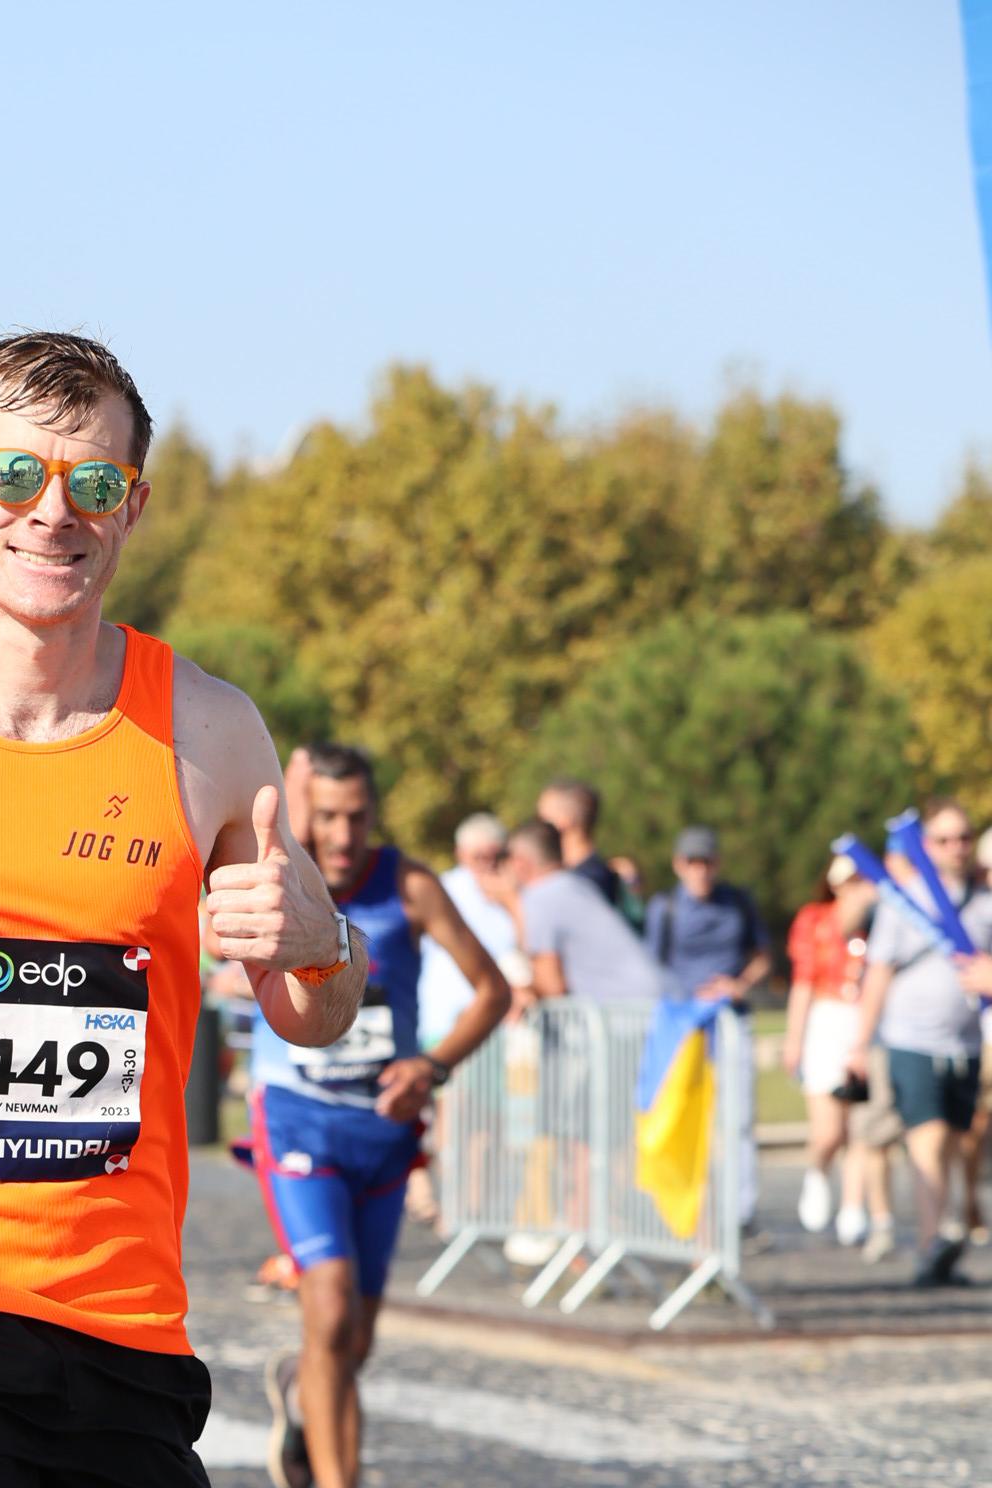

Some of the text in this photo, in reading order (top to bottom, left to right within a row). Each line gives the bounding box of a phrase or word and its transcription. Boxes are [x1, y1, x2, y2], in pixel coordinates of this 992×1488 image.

[62, 831, 162, 868] JOG ON
[18, 952, 87, 996] edp
[84, 1014, 136, 1030] HOKA
[121, 1049, 137, 1094] <3h30
[5, 1102, 58, 1114] NEWMAN
[100, 1106, 130, 1117] 2023
